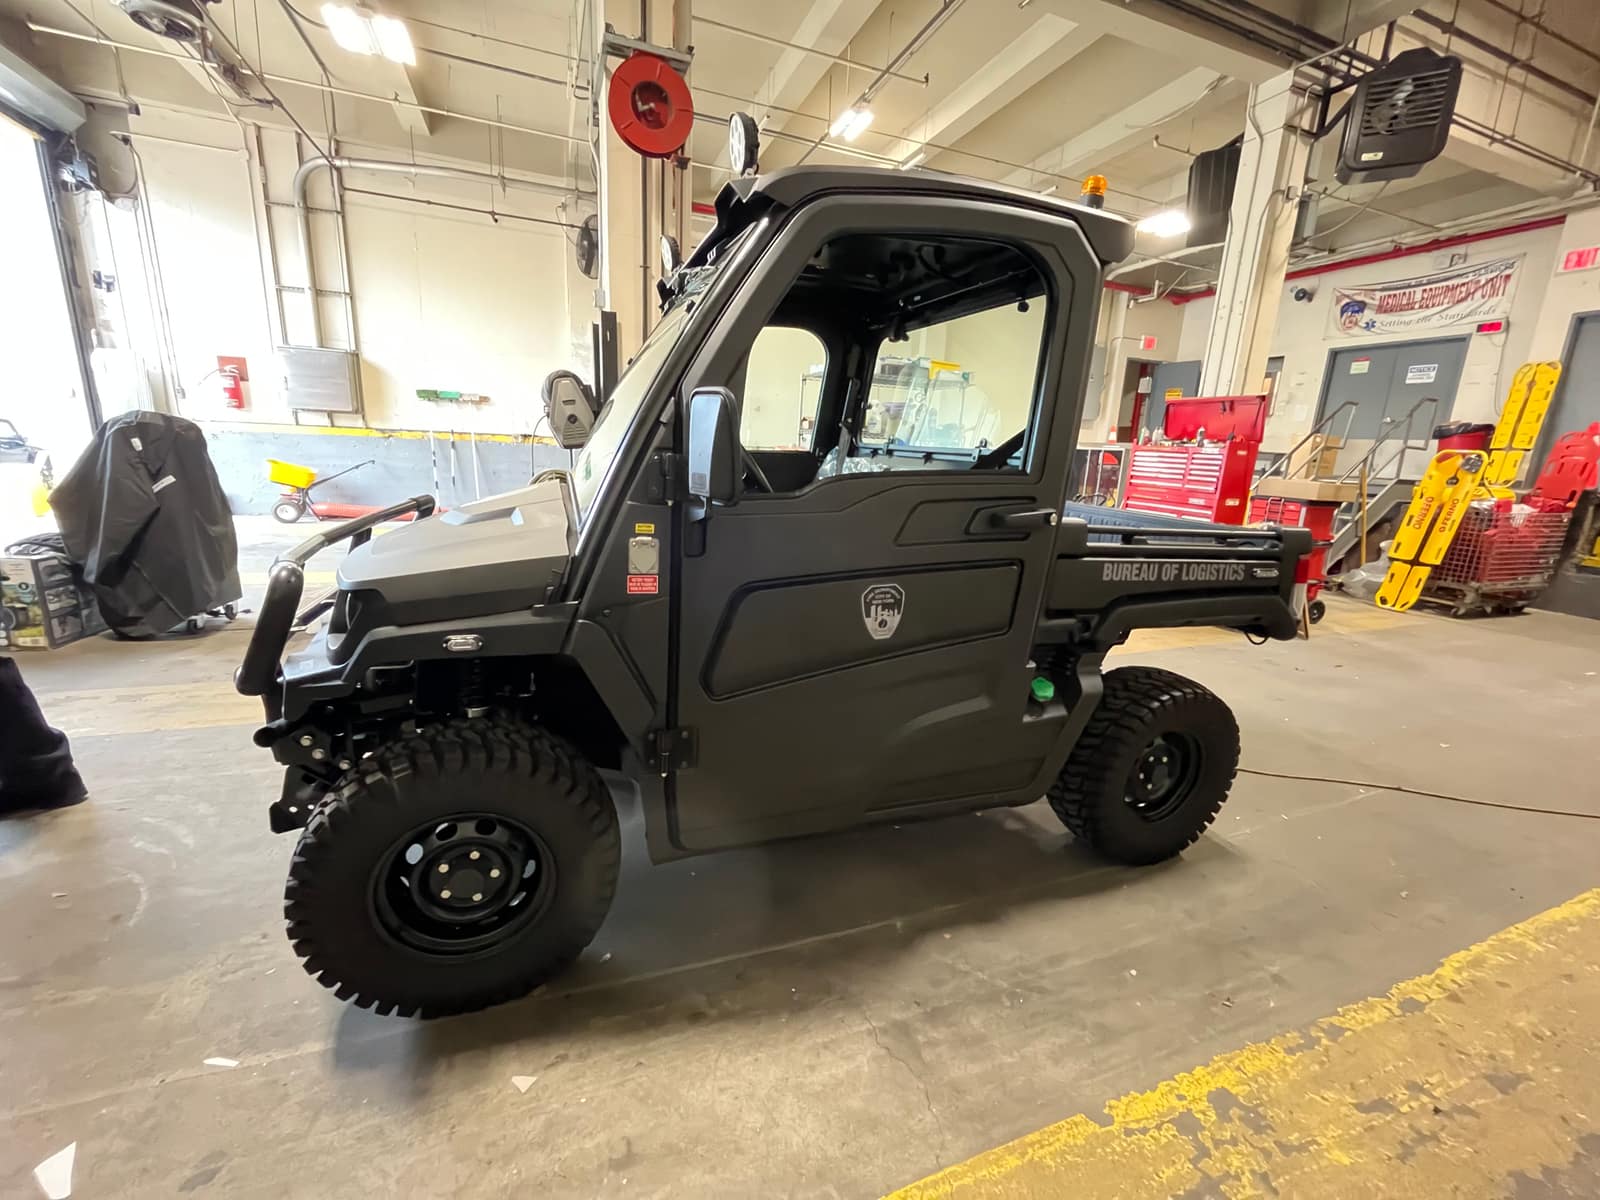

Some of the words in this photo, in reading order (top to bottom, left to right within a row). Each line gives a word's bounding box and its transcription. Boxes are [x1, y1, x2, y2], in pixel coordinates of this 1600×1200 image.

[1564, 247, 1600, 270] EXIT
[1375, 290, 1418, 314] MEDICAL
[1420, 279, 1481, 309] EQUIPMENT
[1481, 273, 1512, 299] UNIT
[1377, 317, 1413, 329] Setting
[1416, 316, 1431, 324] the
[1102, 562, 1159, 581] BUREAU
[1161, 563, 1180, 581] OF
[1182, 563, 1246, 581] LOGISTICS
